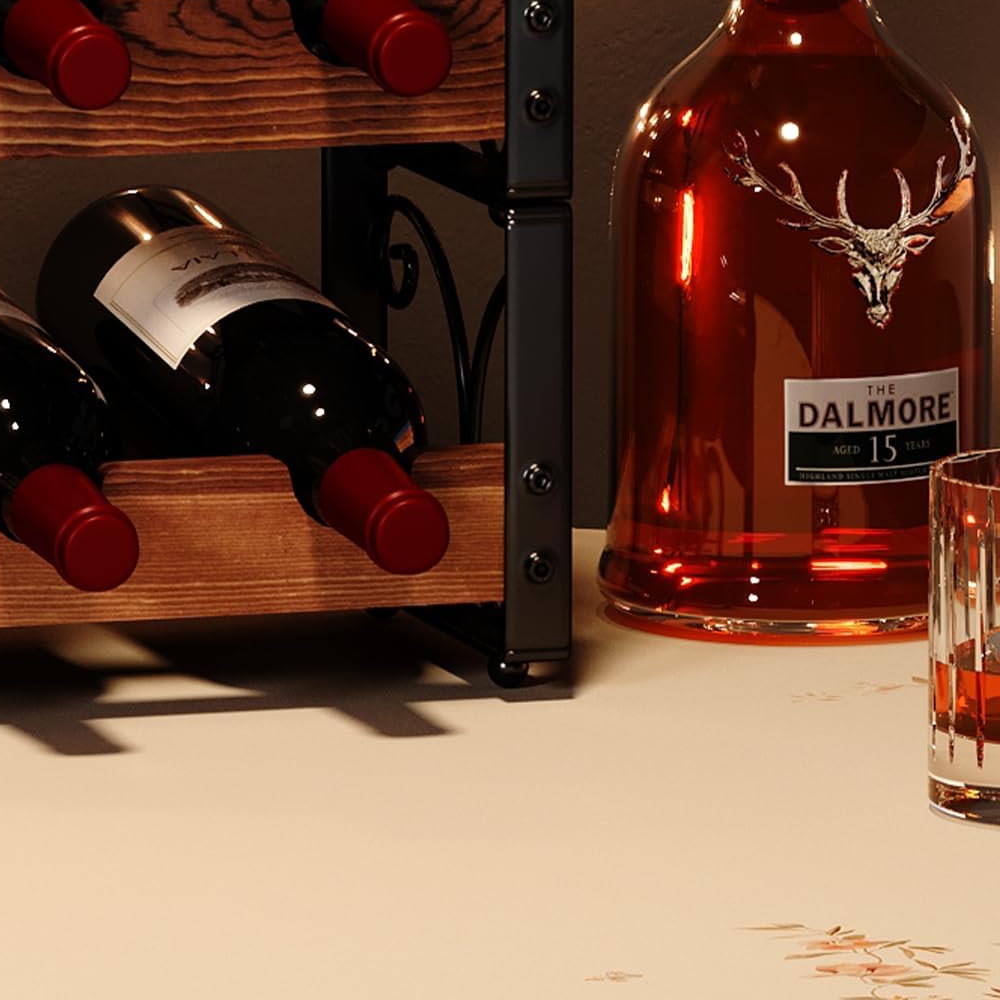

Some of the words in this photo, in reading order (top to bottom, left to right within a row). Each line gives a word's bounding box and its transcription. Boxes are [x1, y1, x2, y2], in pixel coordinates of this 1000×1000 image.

[866, 383, 896, 397] THE
[799, 391, 951, 429] DALMORE
[832, 445, 861, 456] AGED
[869, 433, 898, 464] 15
[904, 439, 931, 452] YEARS
